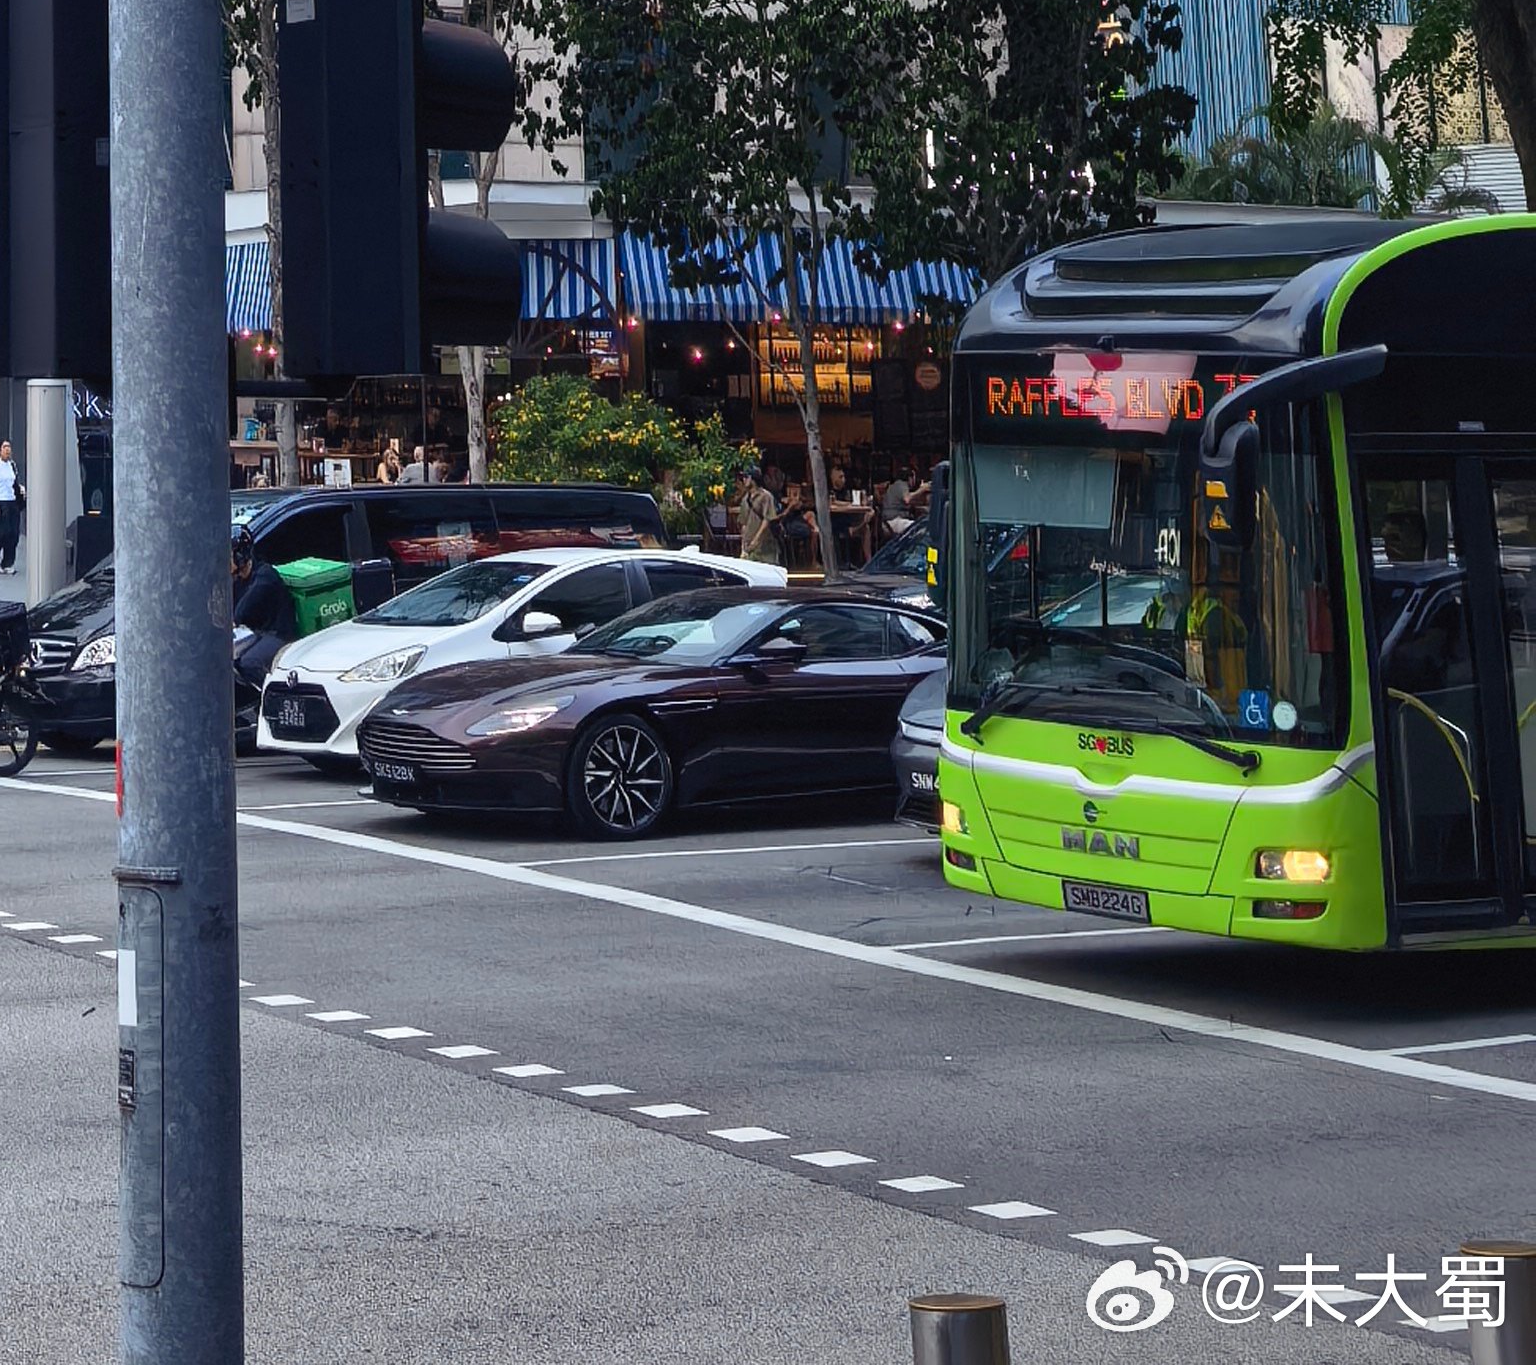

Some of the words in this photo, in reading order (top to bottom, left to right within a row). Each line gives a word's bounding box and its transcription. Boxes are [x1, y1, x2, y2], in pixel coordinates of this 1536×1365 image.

[987, 376, 1115, 417] RAFFLES
[1126, 378, 1205, 420] BLVD
[319, 598, 347, 617] Grab
[1062, 826, 1141, 861] MAN
[1070, 885, 1144, 915] SMB224G
